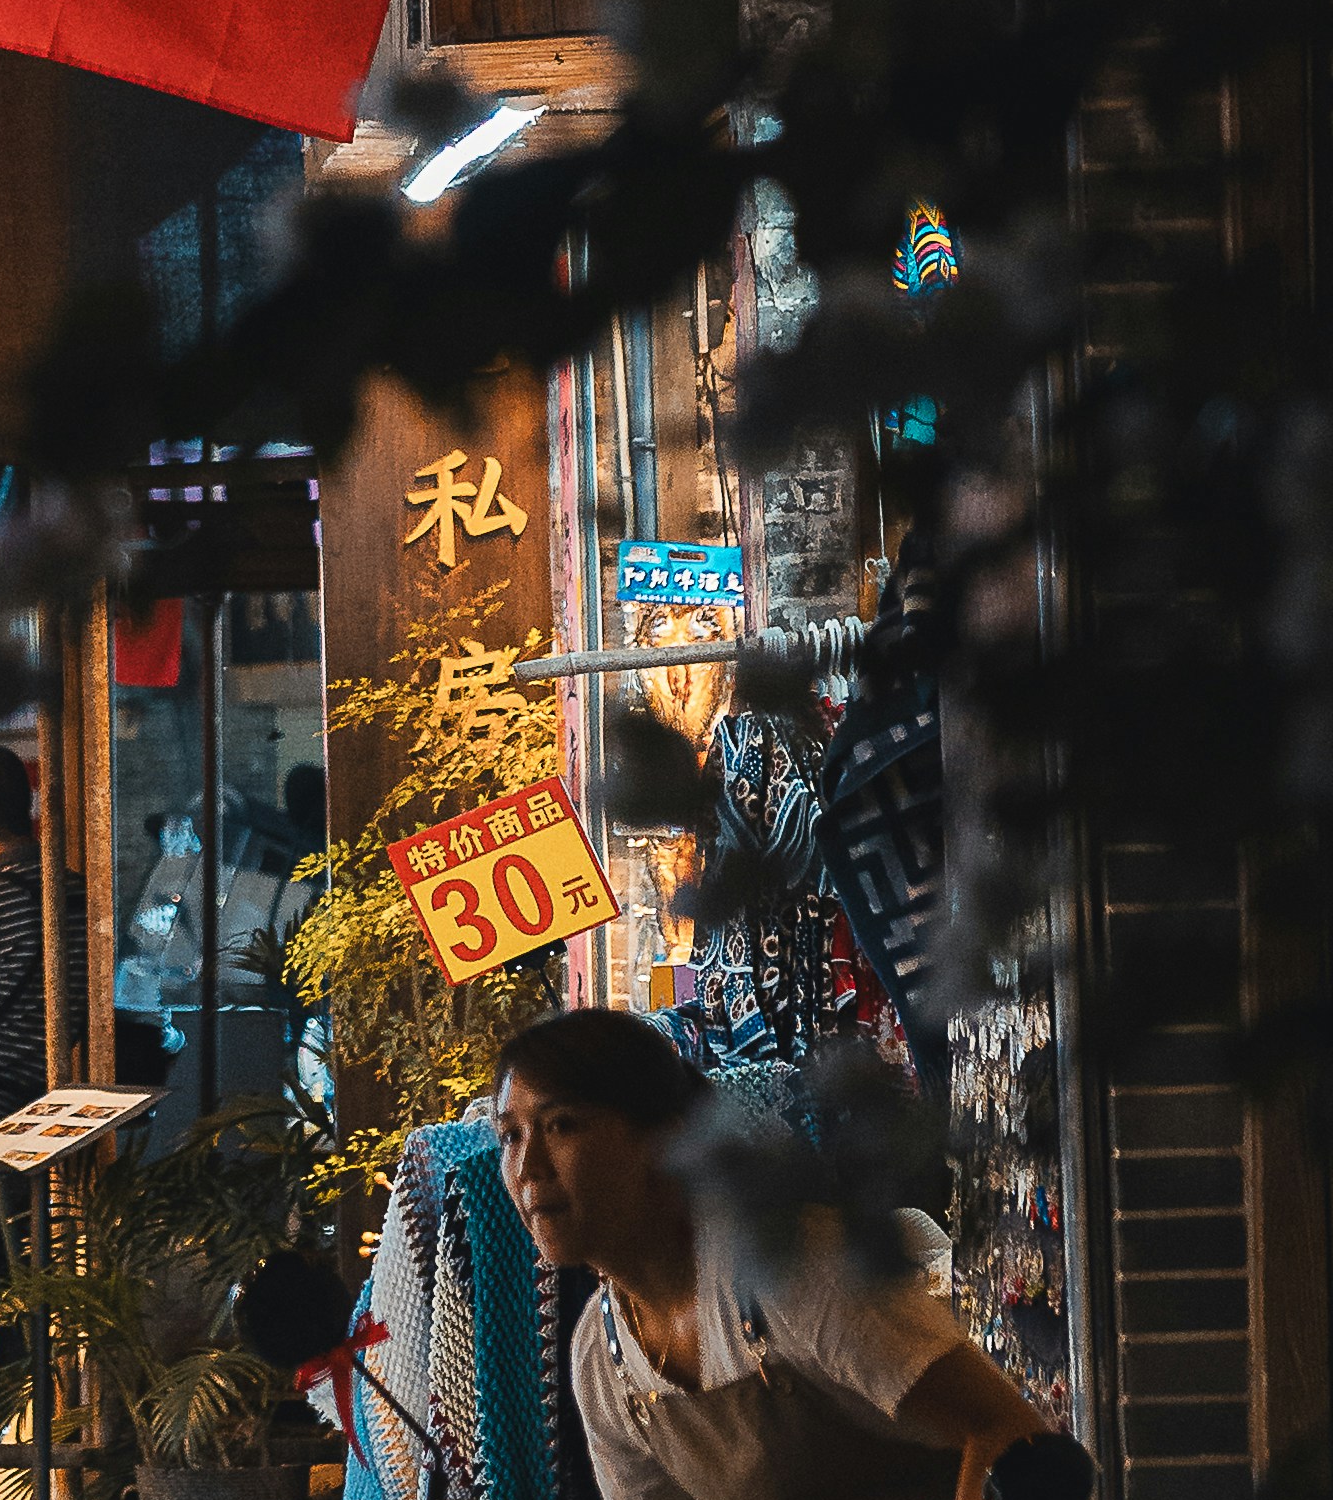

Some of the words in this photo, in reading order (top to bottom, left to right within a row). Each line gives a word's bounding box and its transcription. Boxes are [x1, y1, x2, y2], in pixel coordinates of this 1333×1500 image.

[406, 790, 565, 875] 特价商品
[430, 852, 557, 966] 30
[561, 874, 600, 917] 元
